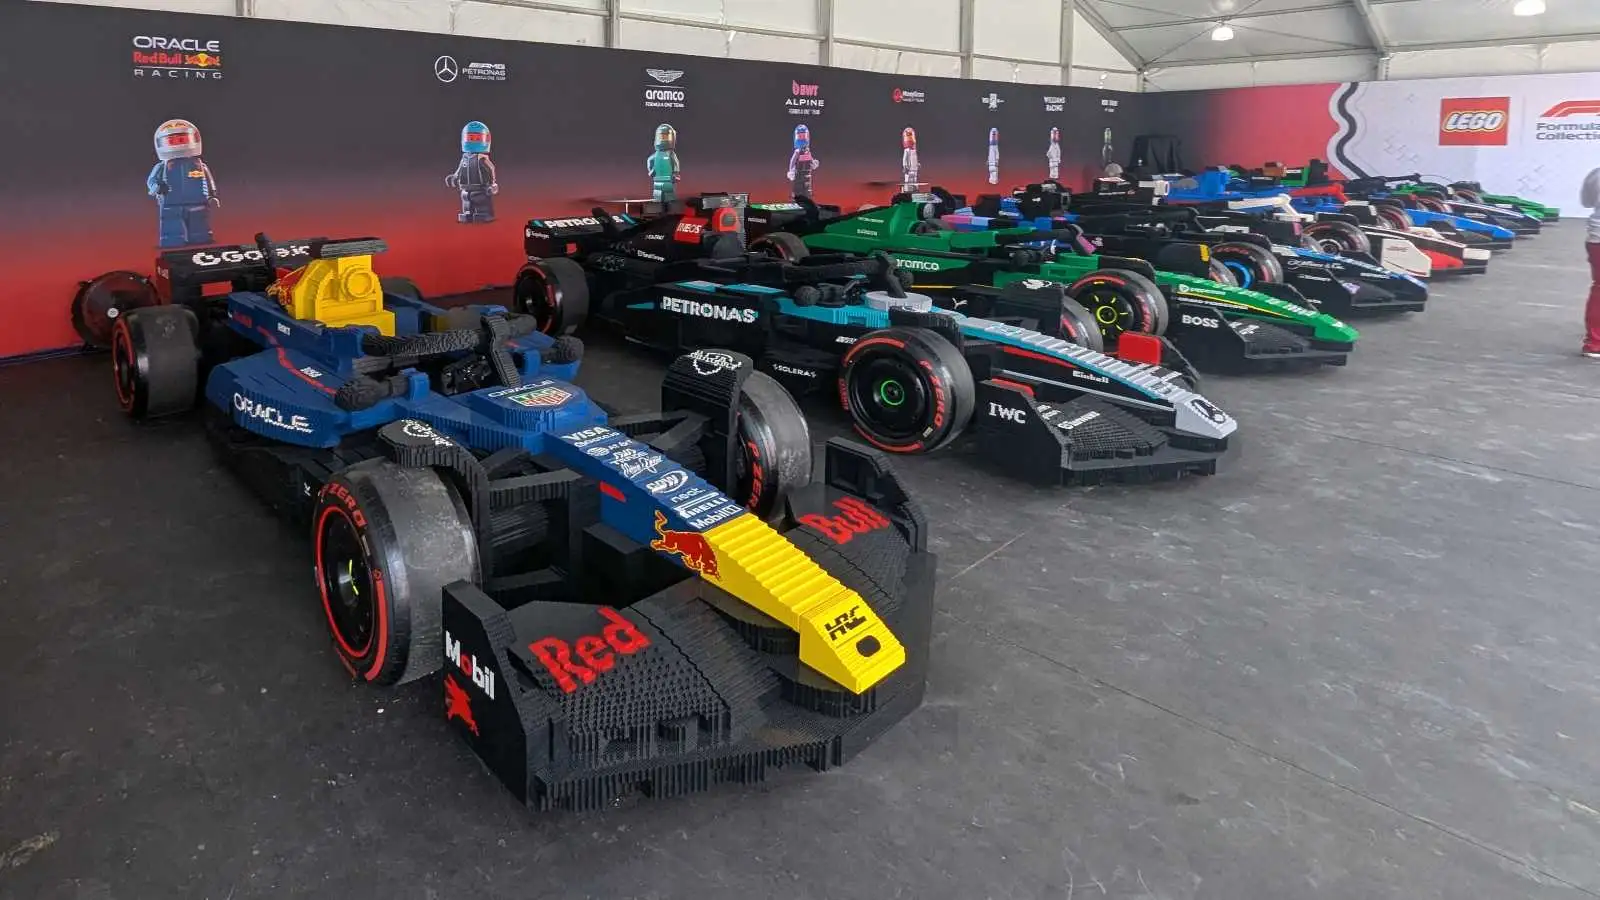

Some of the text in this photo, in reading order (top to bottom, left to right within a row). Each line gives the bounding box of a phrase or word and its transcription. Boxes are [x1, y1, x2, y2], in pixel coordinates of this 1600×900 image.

[133, 36, 220, 52] ORACLE
[133, 51, 182, 65] Red Bull
[134, 69, 222, 79] RACING
[462, 67, 506, 76] PETRONAS
[645, 89, 685, 101] aramco
[785, 98, 825, 107] ALPINE
[1444, 111, 1504, 131] LEGO
[677, 222, 703, 234] INEOS
[662, 296, 755, 324] PETRONAS
[1182, 314, 1219, 329] BOSS
[487, 380, 556, 398] ORACLE
[233, 392, 314, 434] ORACLE
[988, 402, 1027, 424] IWC
[560, 426, 610, 441] VISA
[327, 482, 368, 528] ZERO
[674, 491, 729, 519] PIRELLI
[799, 496, 891, 545] Bull
[825, 605, 867, 641] HRC
[528, 604, 652, 694] Red
[445, 630, 495, 700] Mobil
